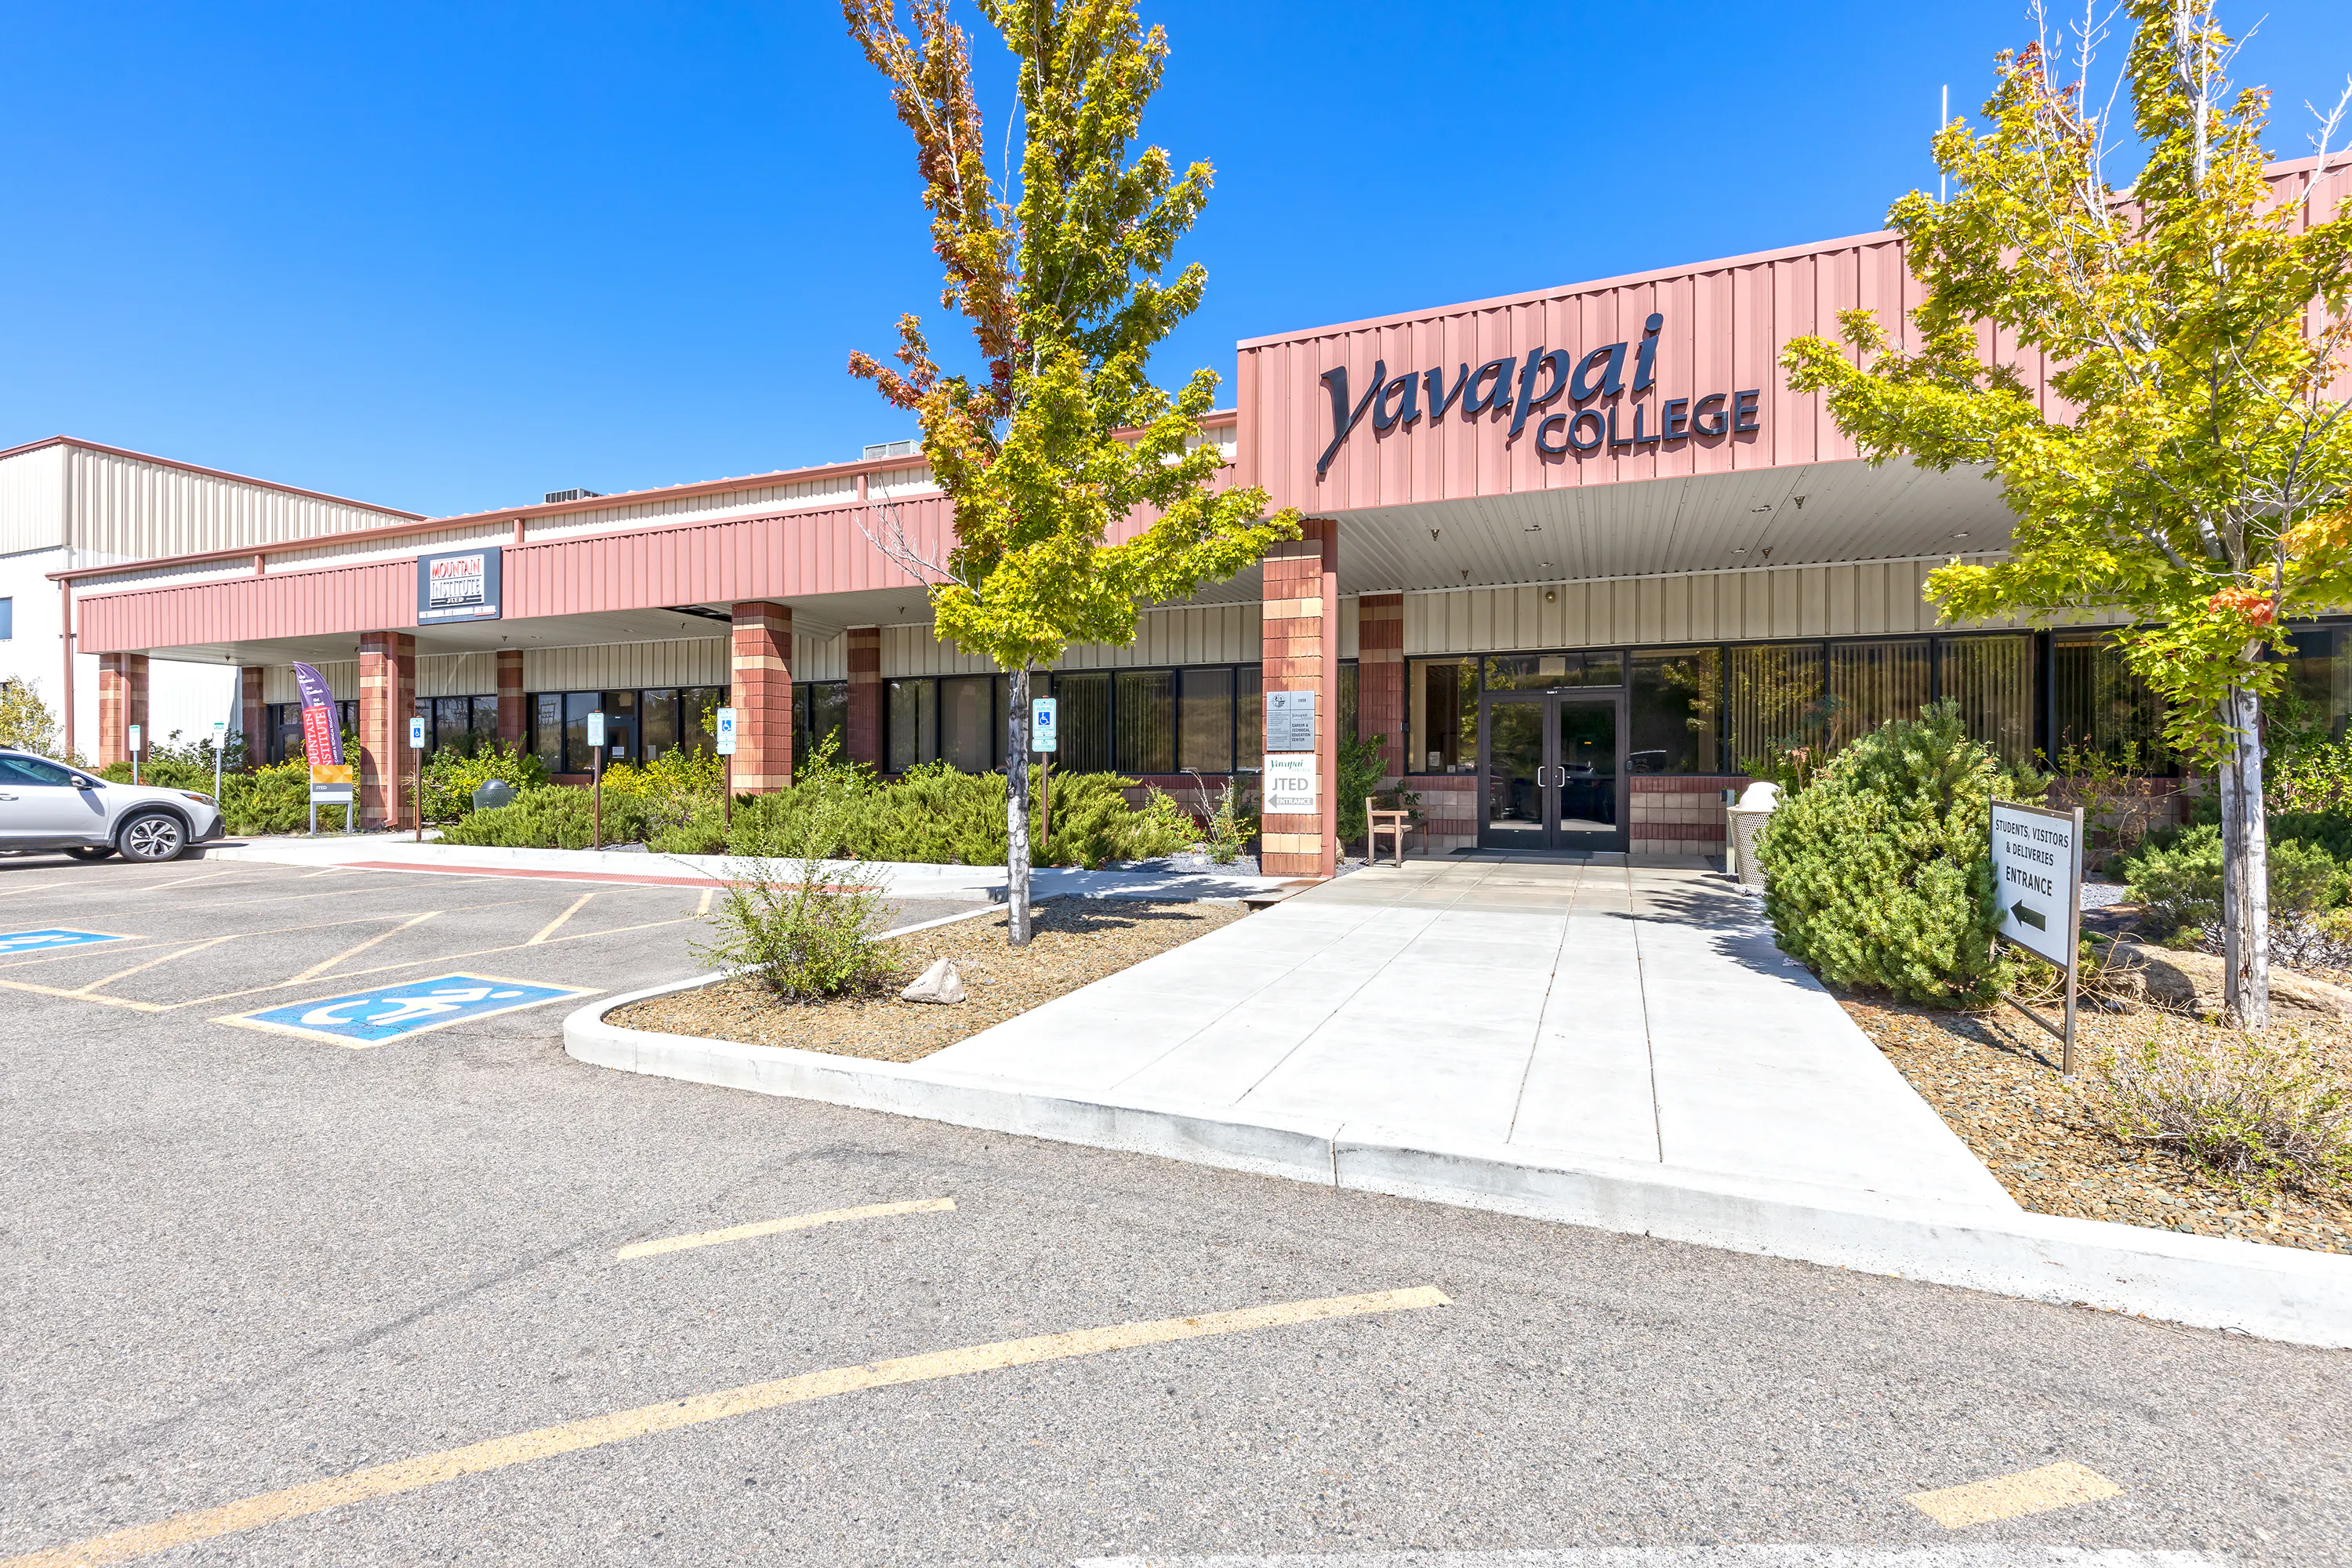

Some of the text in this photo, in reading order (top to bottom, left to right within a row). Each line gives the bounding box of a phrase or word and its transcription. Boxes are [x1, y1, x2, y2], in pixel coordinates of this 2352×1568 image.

[1316, 312, 1664, 474] Yavapai
[1537, 389, 1761, 453] COLLEGE
[431, 558, 481, 579] MOUNTAIN
[432, 578, 480, 598] INSTITUTE
[306, 713, 320, 765] OUNTAIN
[315, 711, 332, 765] NSTITUTE
[1269, 759, 1303, 772] Yavapai
[1272, 778, 1308, 791] JTED
[1995, 819, 2069, 848] STUDENTS, VISITORS
[2005, 841, 2054, 866] & DELIVERIES
[2005, 866, 2053, 897] ENTRANCE
